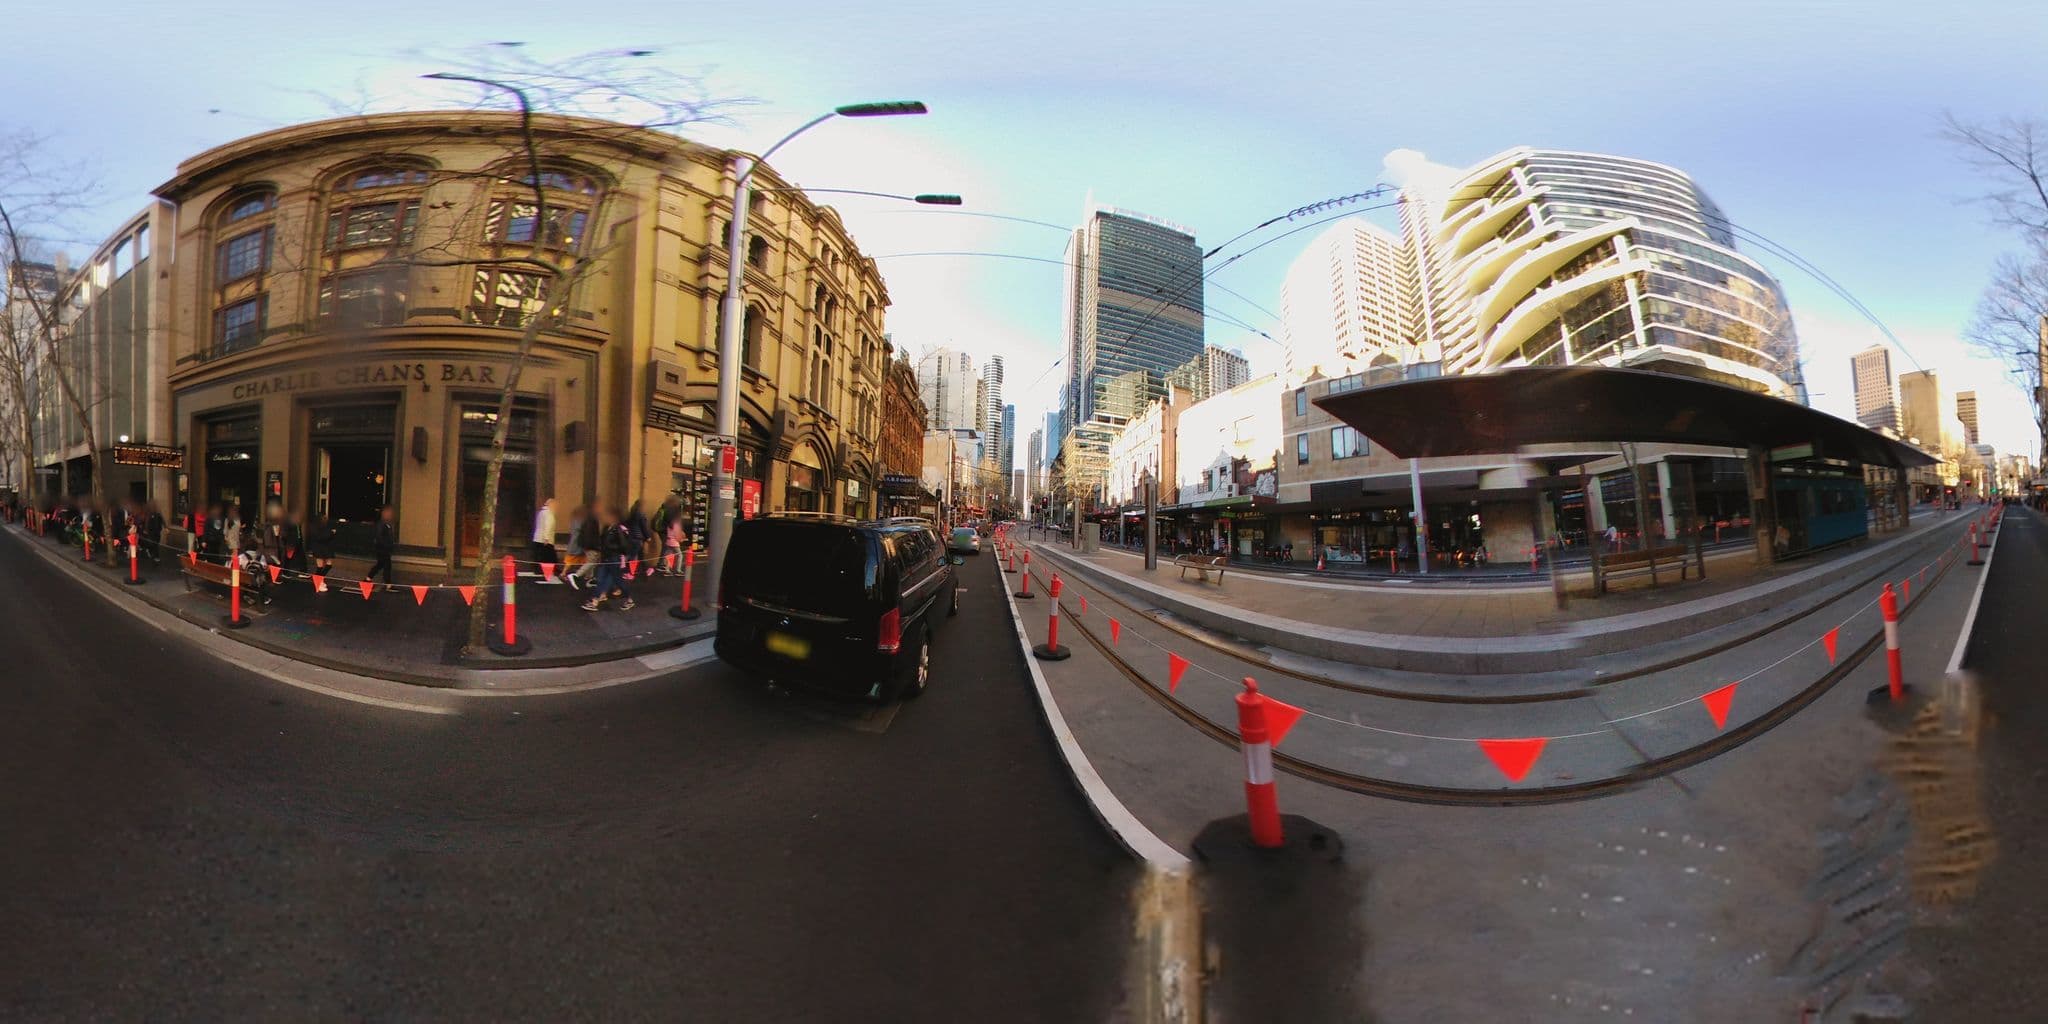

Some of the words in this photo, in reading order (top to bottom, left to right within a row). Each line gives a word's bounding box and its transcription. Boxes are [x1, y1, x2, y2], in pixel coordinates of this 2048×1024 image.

[232, 370, 321, 400] CHARLIE
[335, 363, 426, 386] CHANS
[440, 363, 496, 384] BAR
